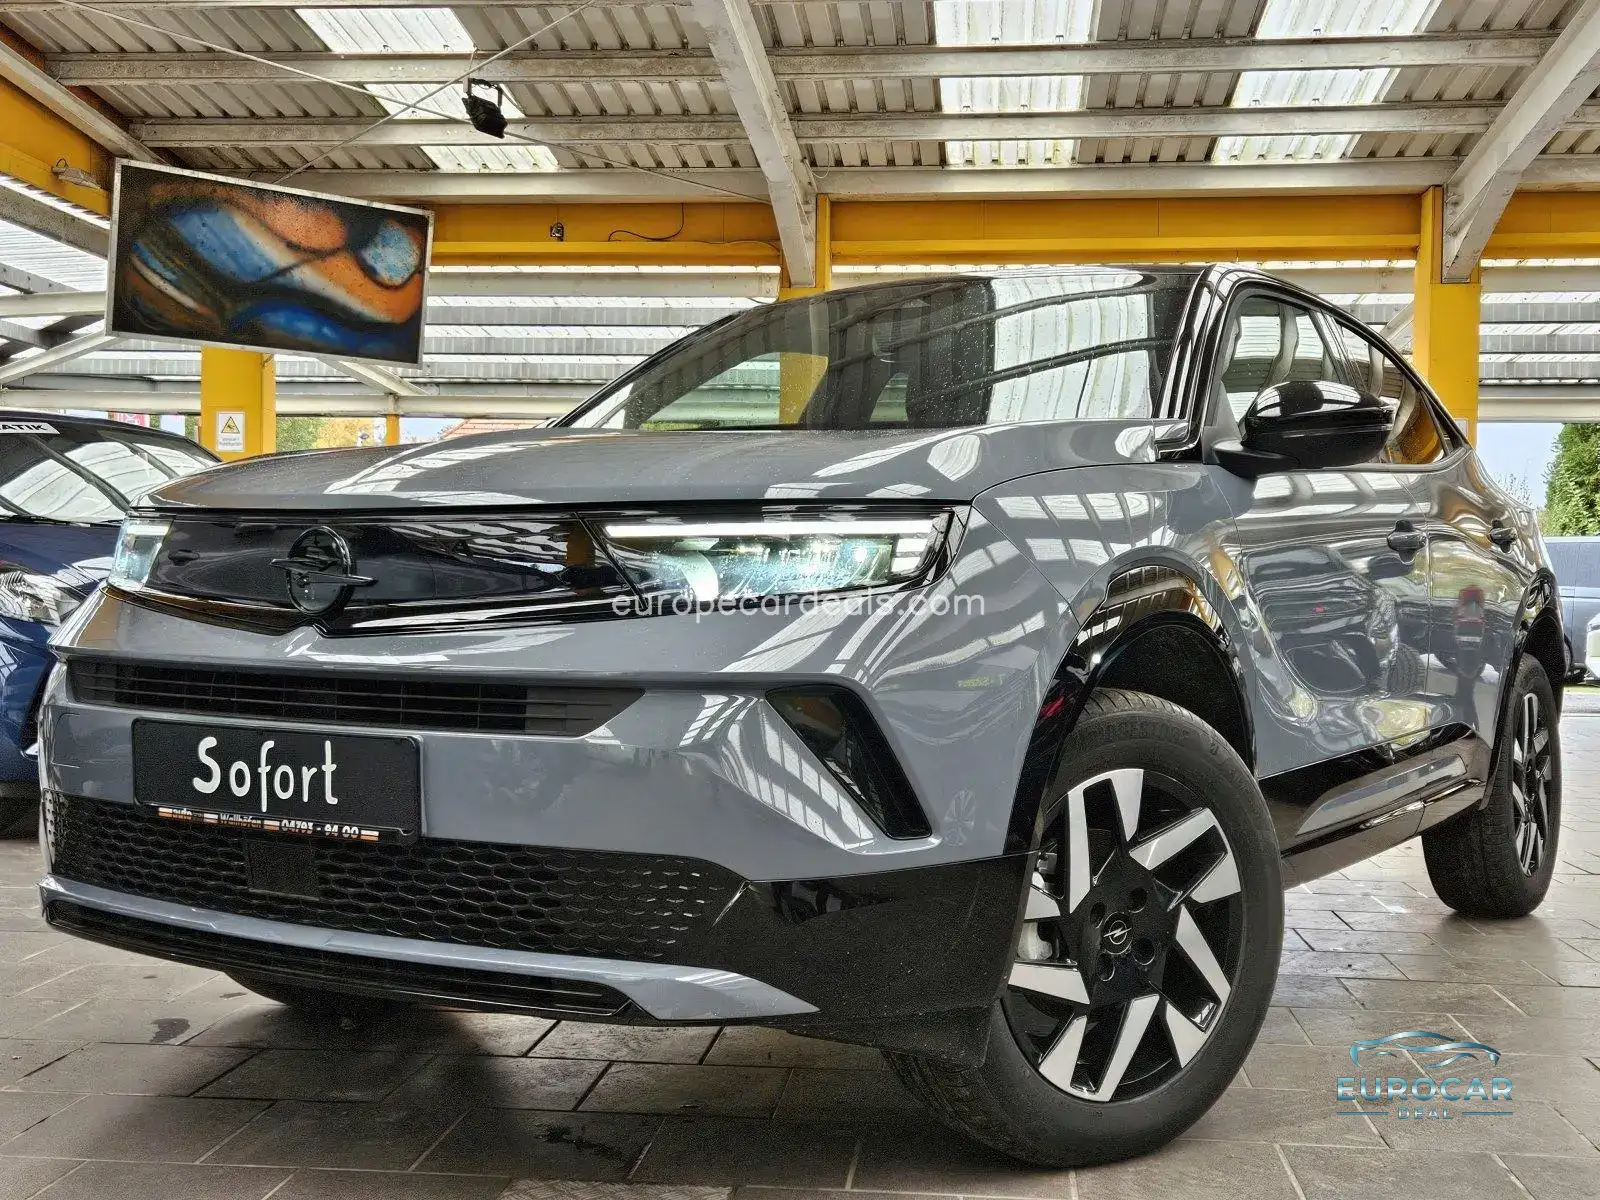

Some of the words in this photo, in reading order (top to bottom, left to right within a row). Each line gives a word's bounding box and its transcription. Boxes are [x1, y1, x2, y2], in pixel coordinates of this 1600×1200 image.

[192, 736, 338, 812] Sofort
[281, 819, 314, 835] 04793
[342, 826, 359, 838] 00
